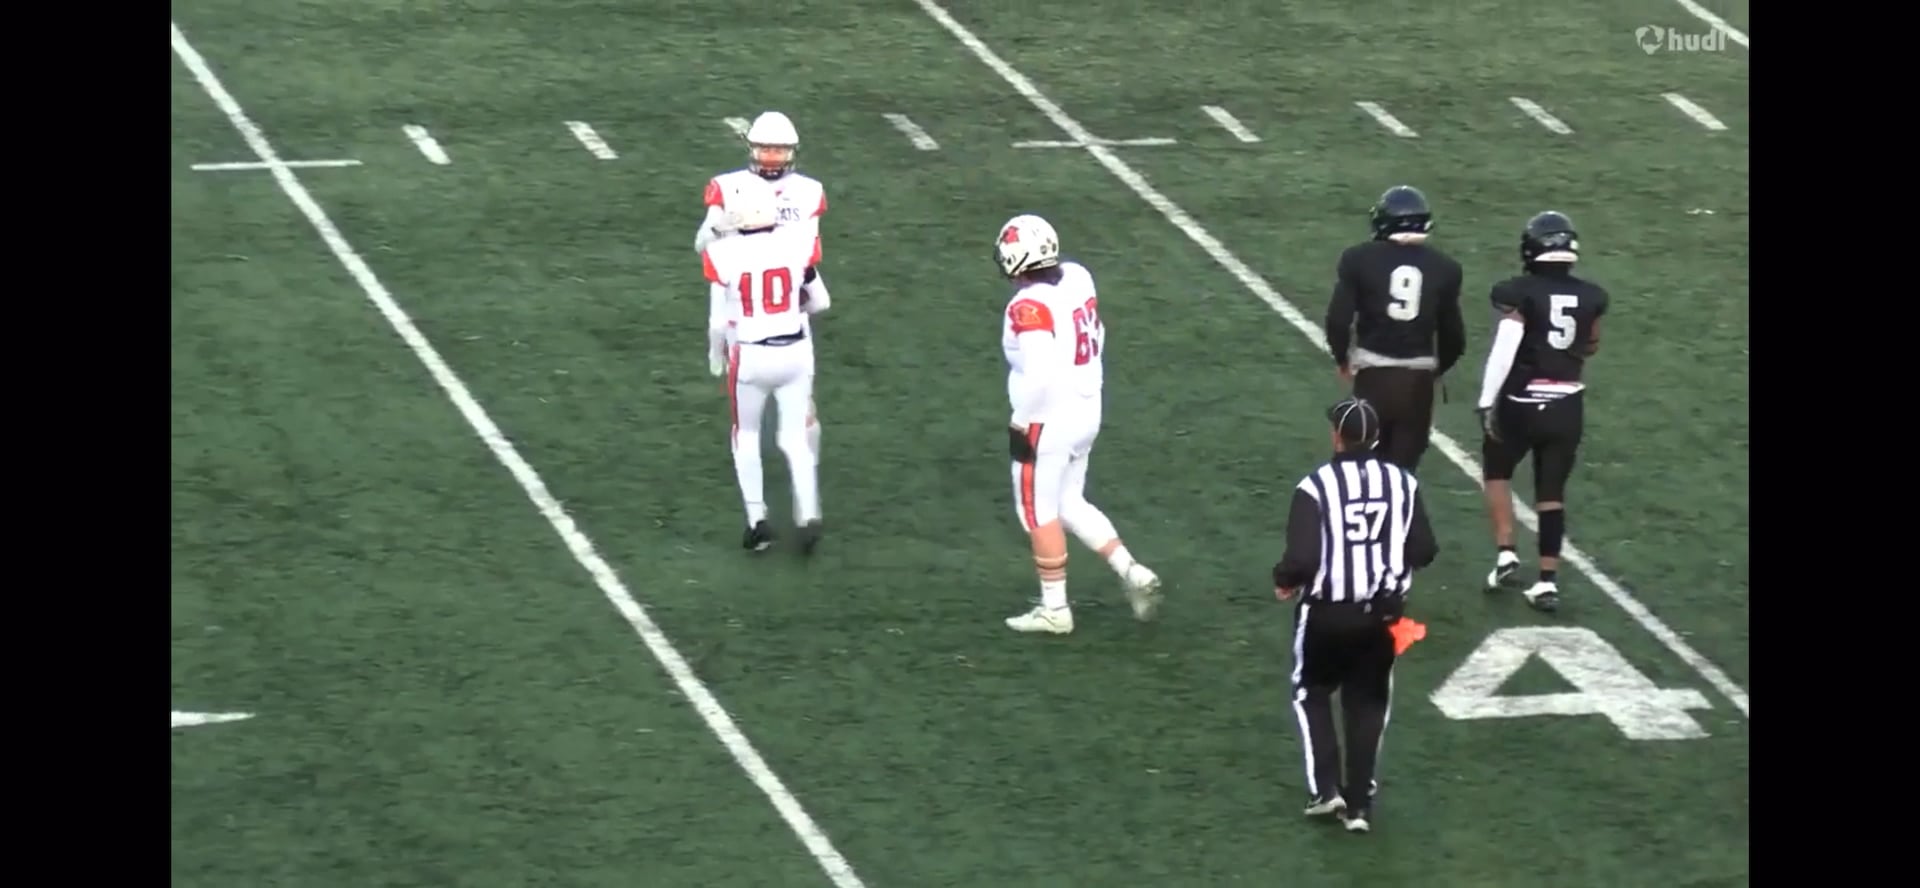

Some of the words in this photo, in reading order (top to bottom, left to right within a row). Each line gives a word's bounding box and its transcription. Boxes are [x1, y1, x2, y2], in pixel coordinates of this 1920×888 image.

[738, 267, 792, 317] 10
[1387, 265, 1423, 321] 9
[1548, 295, 1578, 349] 5
[1345, 502, 1388, 541] 57
[1429, 626, 1713, 739] 4
